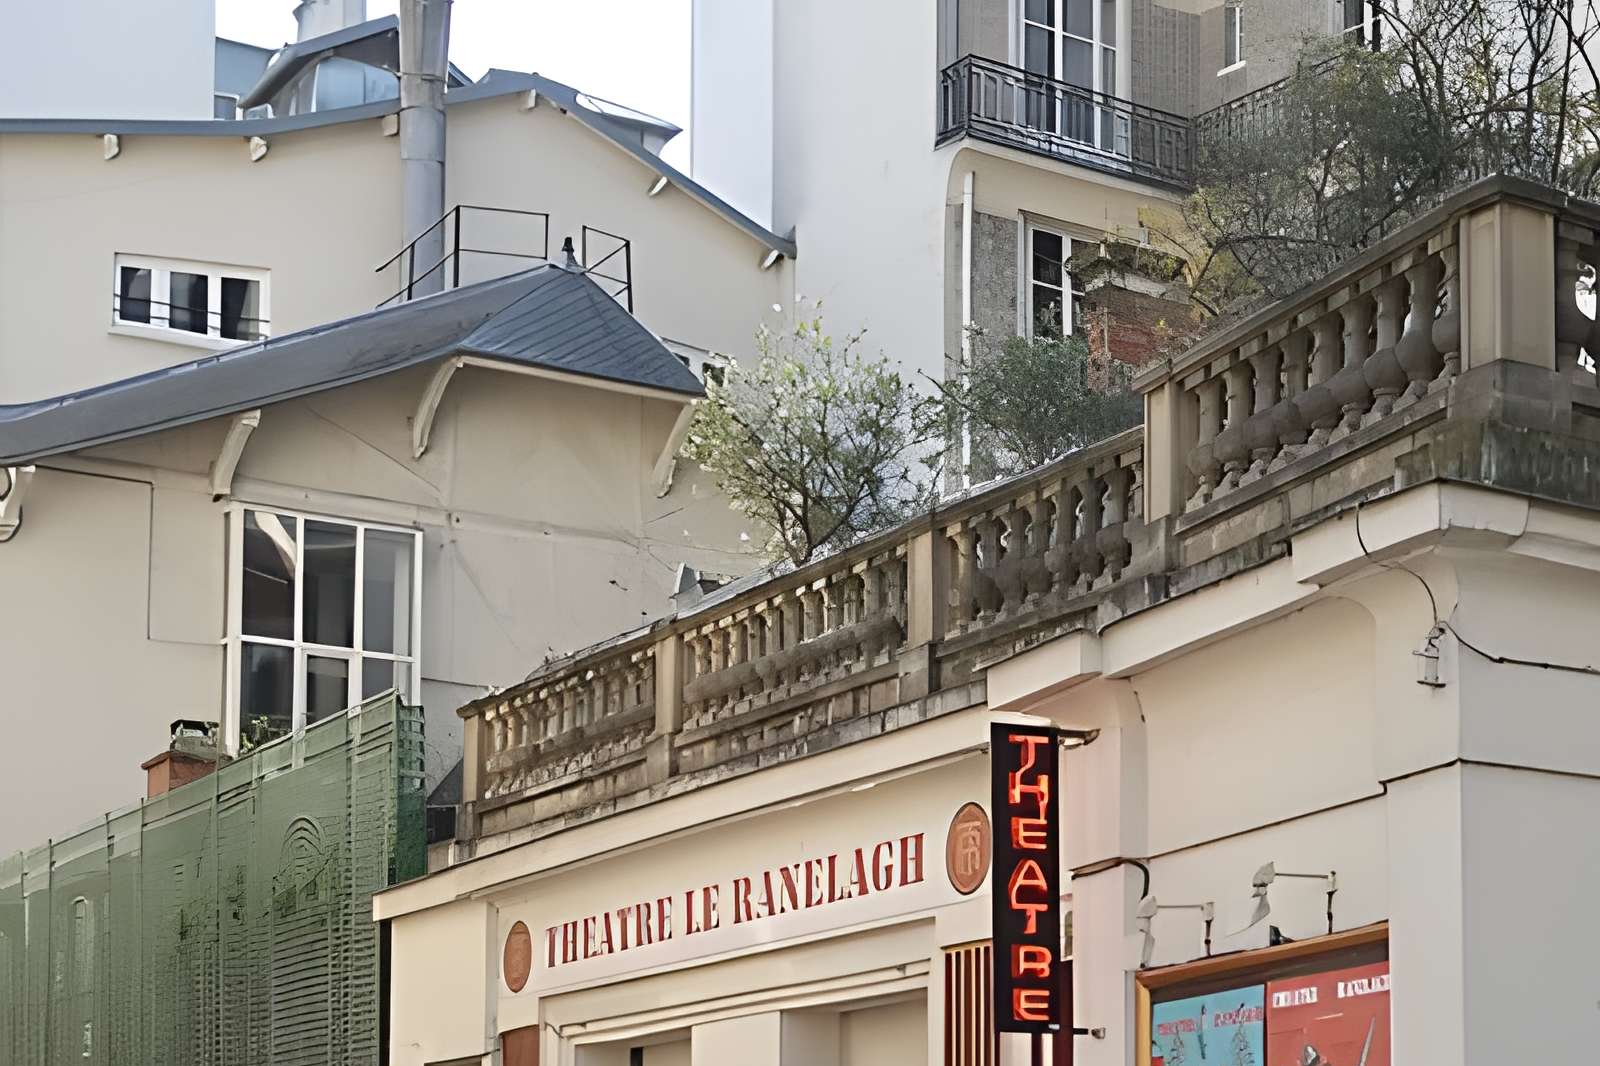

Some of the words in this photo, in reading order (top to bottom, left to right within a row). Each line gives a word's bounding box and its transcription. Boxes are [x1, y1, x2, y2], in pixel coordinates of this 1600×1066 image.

[546, 896, 673, 969] THEATRE
[685, 884, 720, 936] LE
[733, 833, 925, 924] RANELAGH
[1008, 735, 1052, 1021] THEATRE
